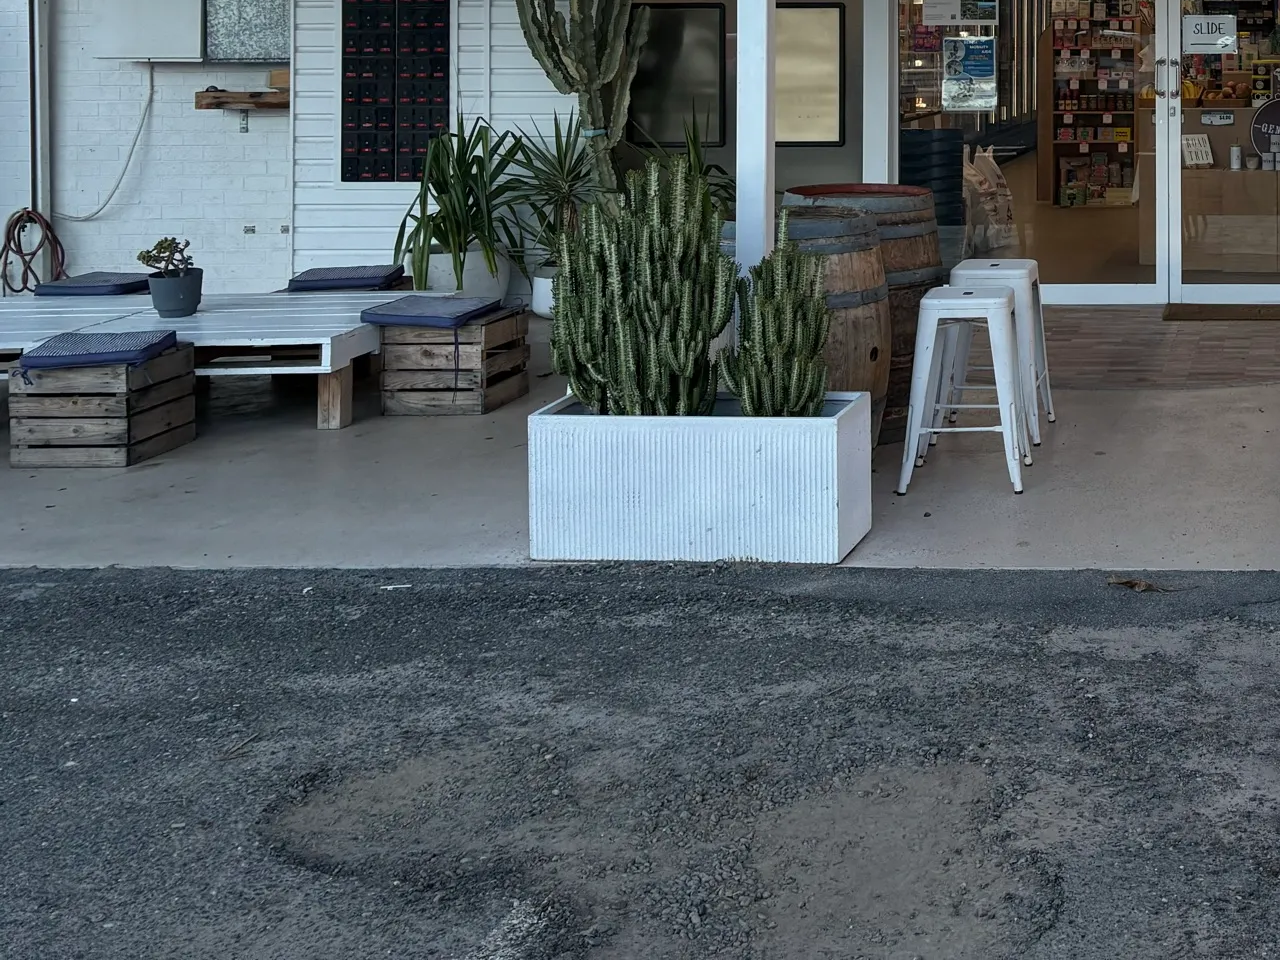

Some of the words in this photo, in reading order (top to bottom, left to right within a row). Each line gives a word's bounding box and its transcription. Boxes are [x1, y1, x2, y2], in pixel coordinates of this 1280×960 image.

[1192, 22, 1226, 35] SLIDE
[1186, 137, 1207, 148] ROAD
[1188, 150, 1209, 161] TRIP
